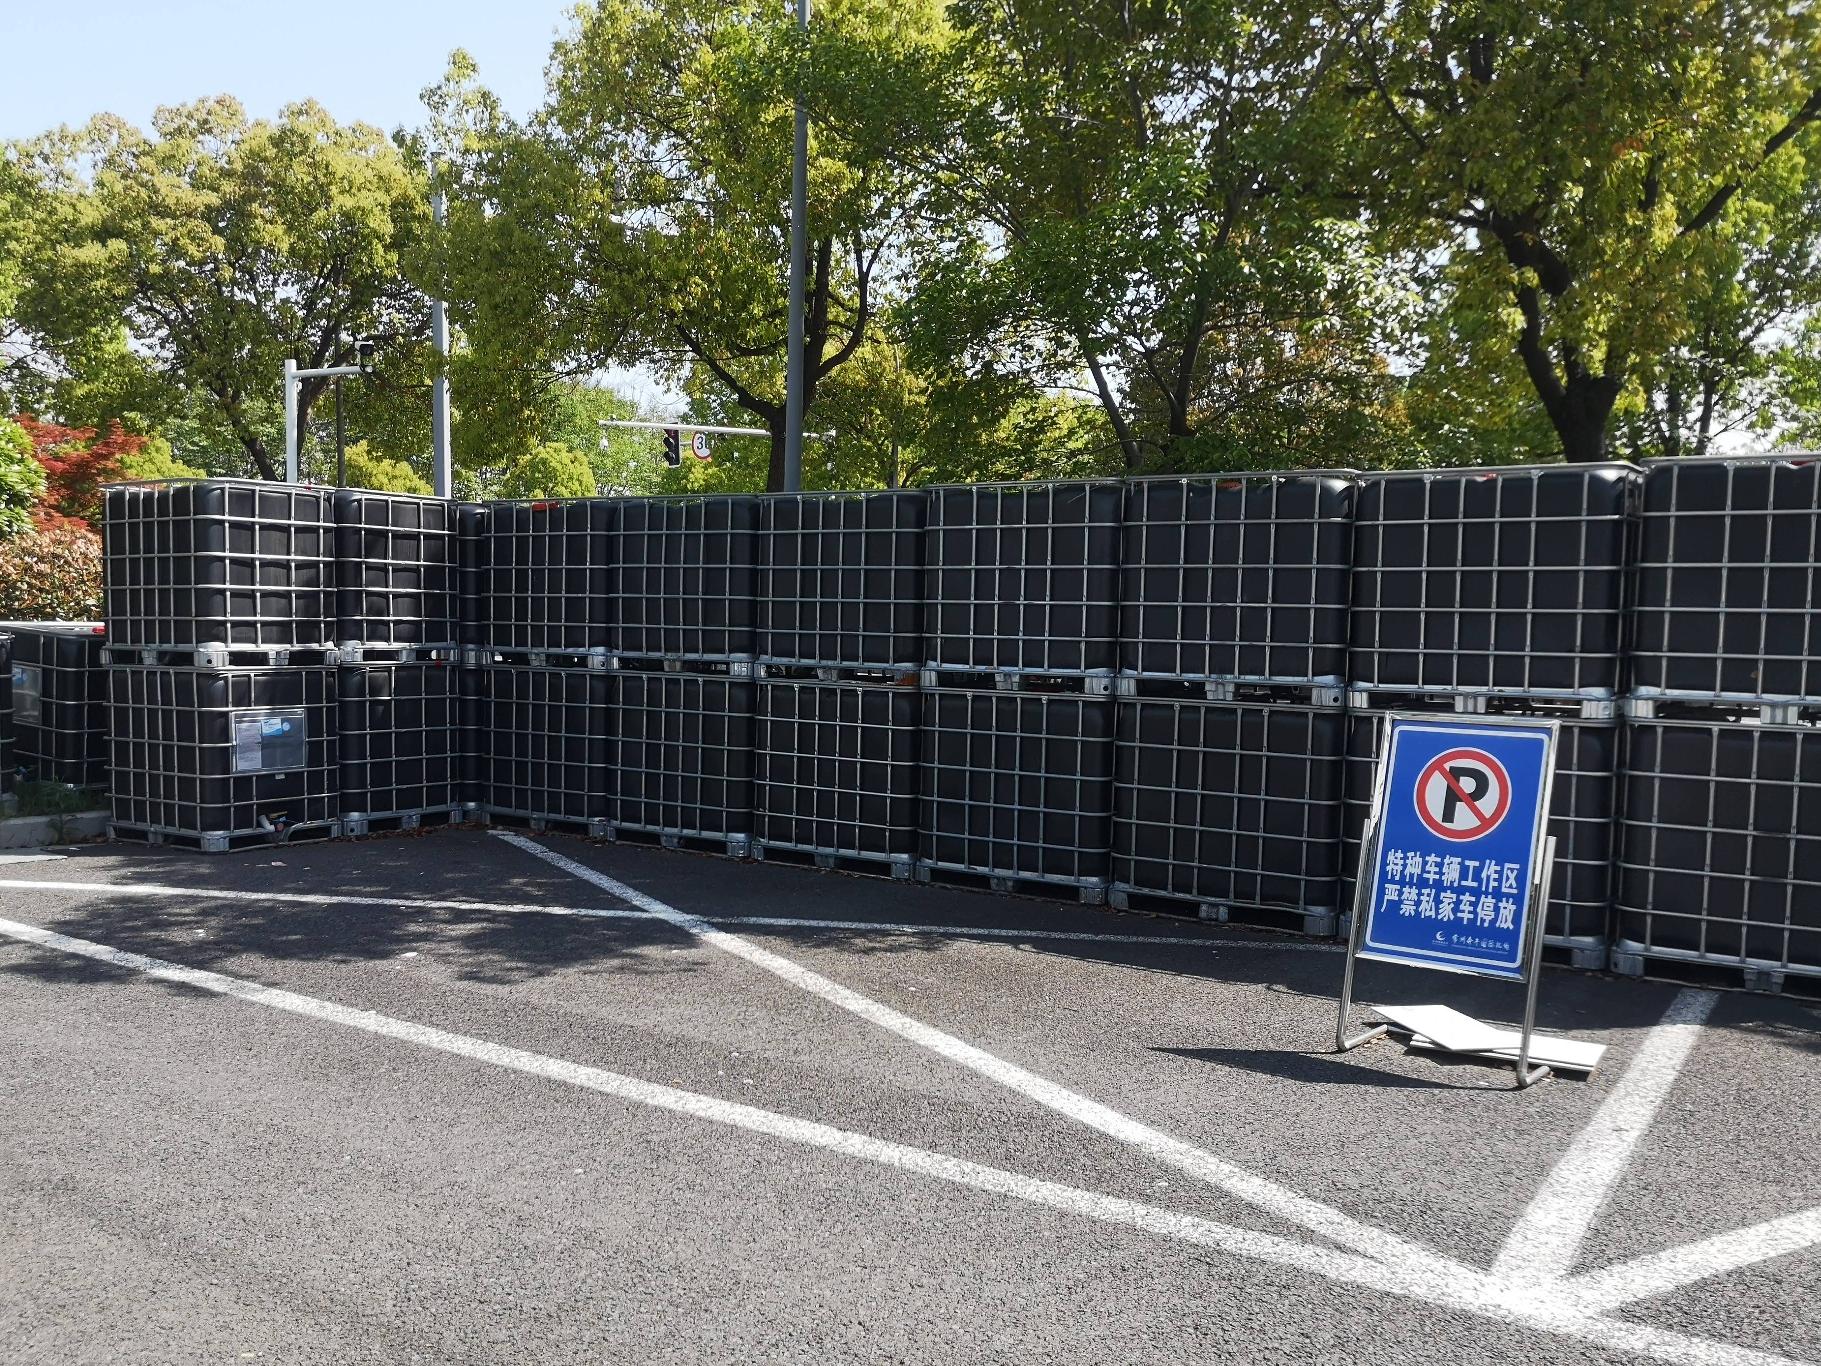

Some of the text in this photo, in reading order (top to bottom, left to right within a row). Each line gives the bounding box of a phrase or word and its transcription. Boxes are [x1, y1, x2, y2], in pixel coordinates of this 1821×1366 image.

[1442, 766, 1489, 823] P
[1386, 848, 1520, 894] 特种车辆工作区
[1381, 883, 1517, 930] 严禁私家车停放
